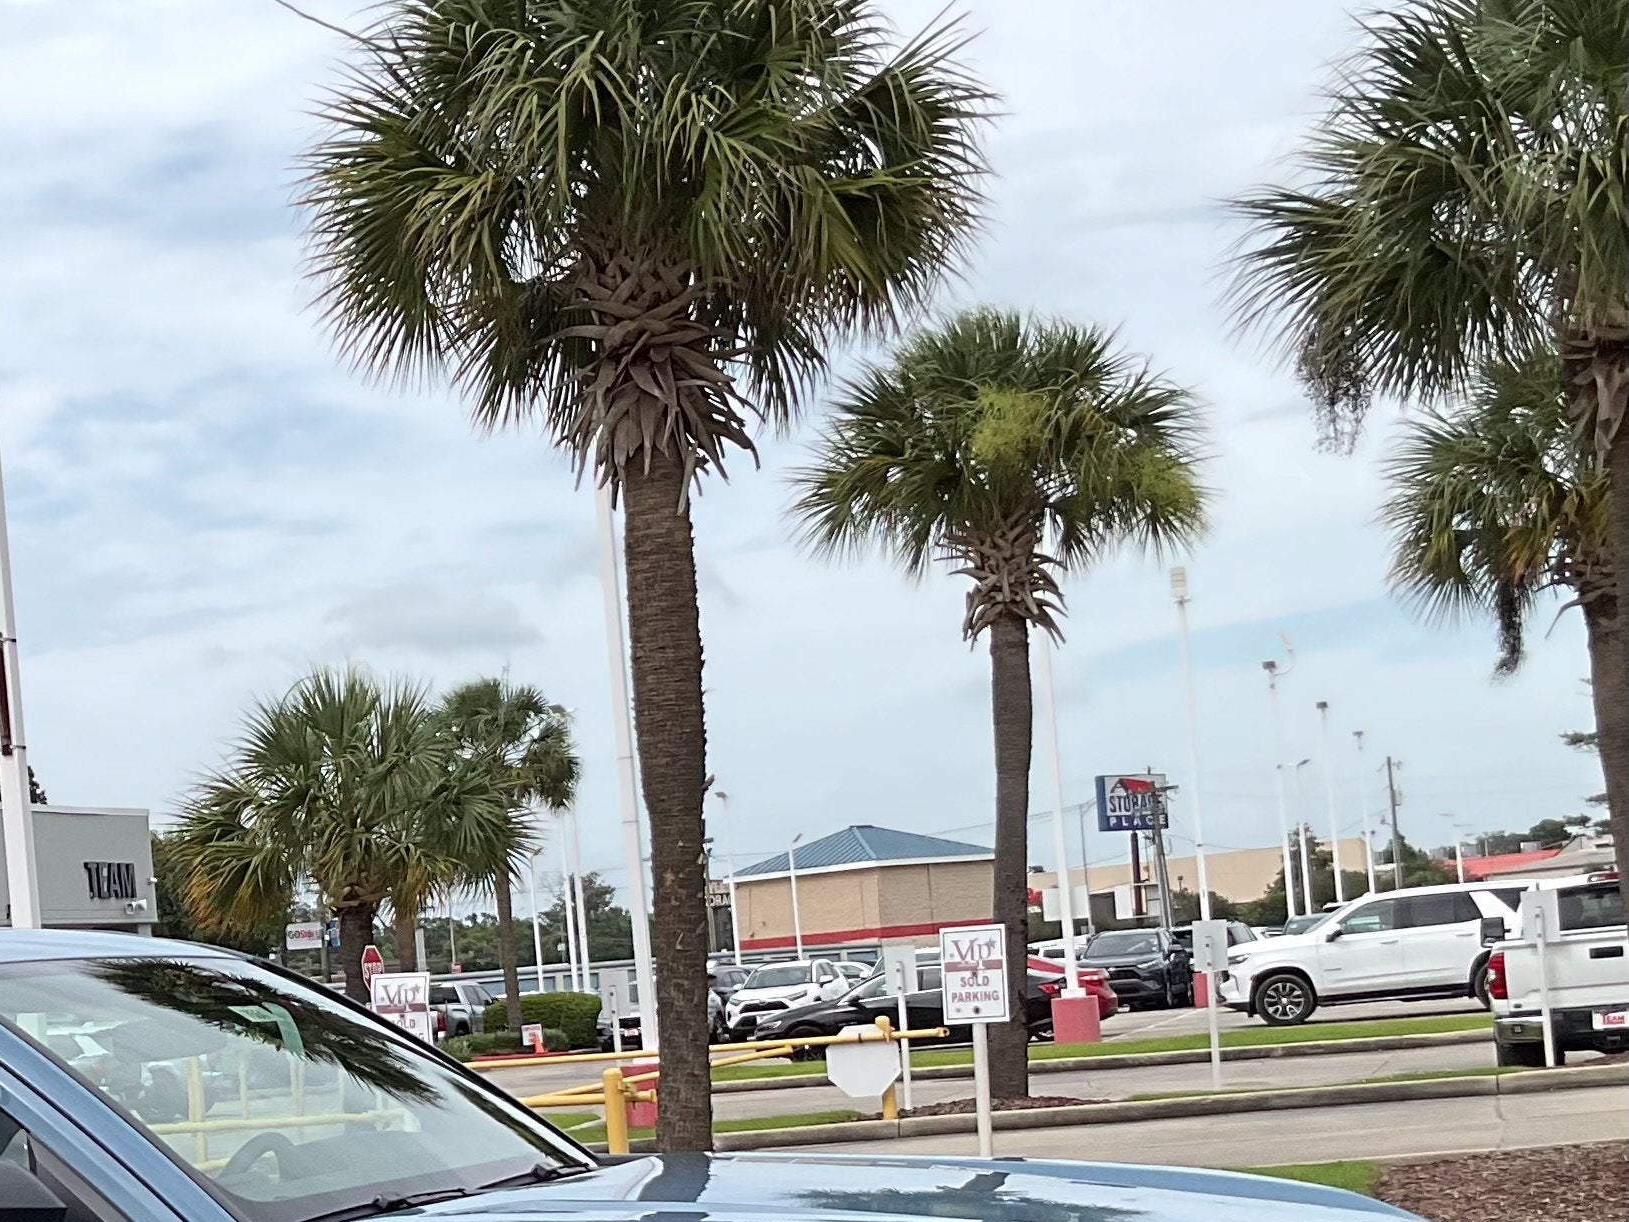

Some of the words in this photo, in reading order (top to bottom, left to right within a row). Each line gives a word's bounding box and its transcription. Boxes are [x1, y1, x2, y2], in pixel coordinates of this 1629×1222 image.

[1109, 793, 1166, 813] STORA
[1110, 814, 1166, 827] PLACE
[83, 862, 137, 899] TEAM
[363, 962, 382, 979] STOP
[960, 976, 990, 988] SOLD
[952, 990, 999, 1003] PARKING
[392, 1019, 416, 1029] OLD
